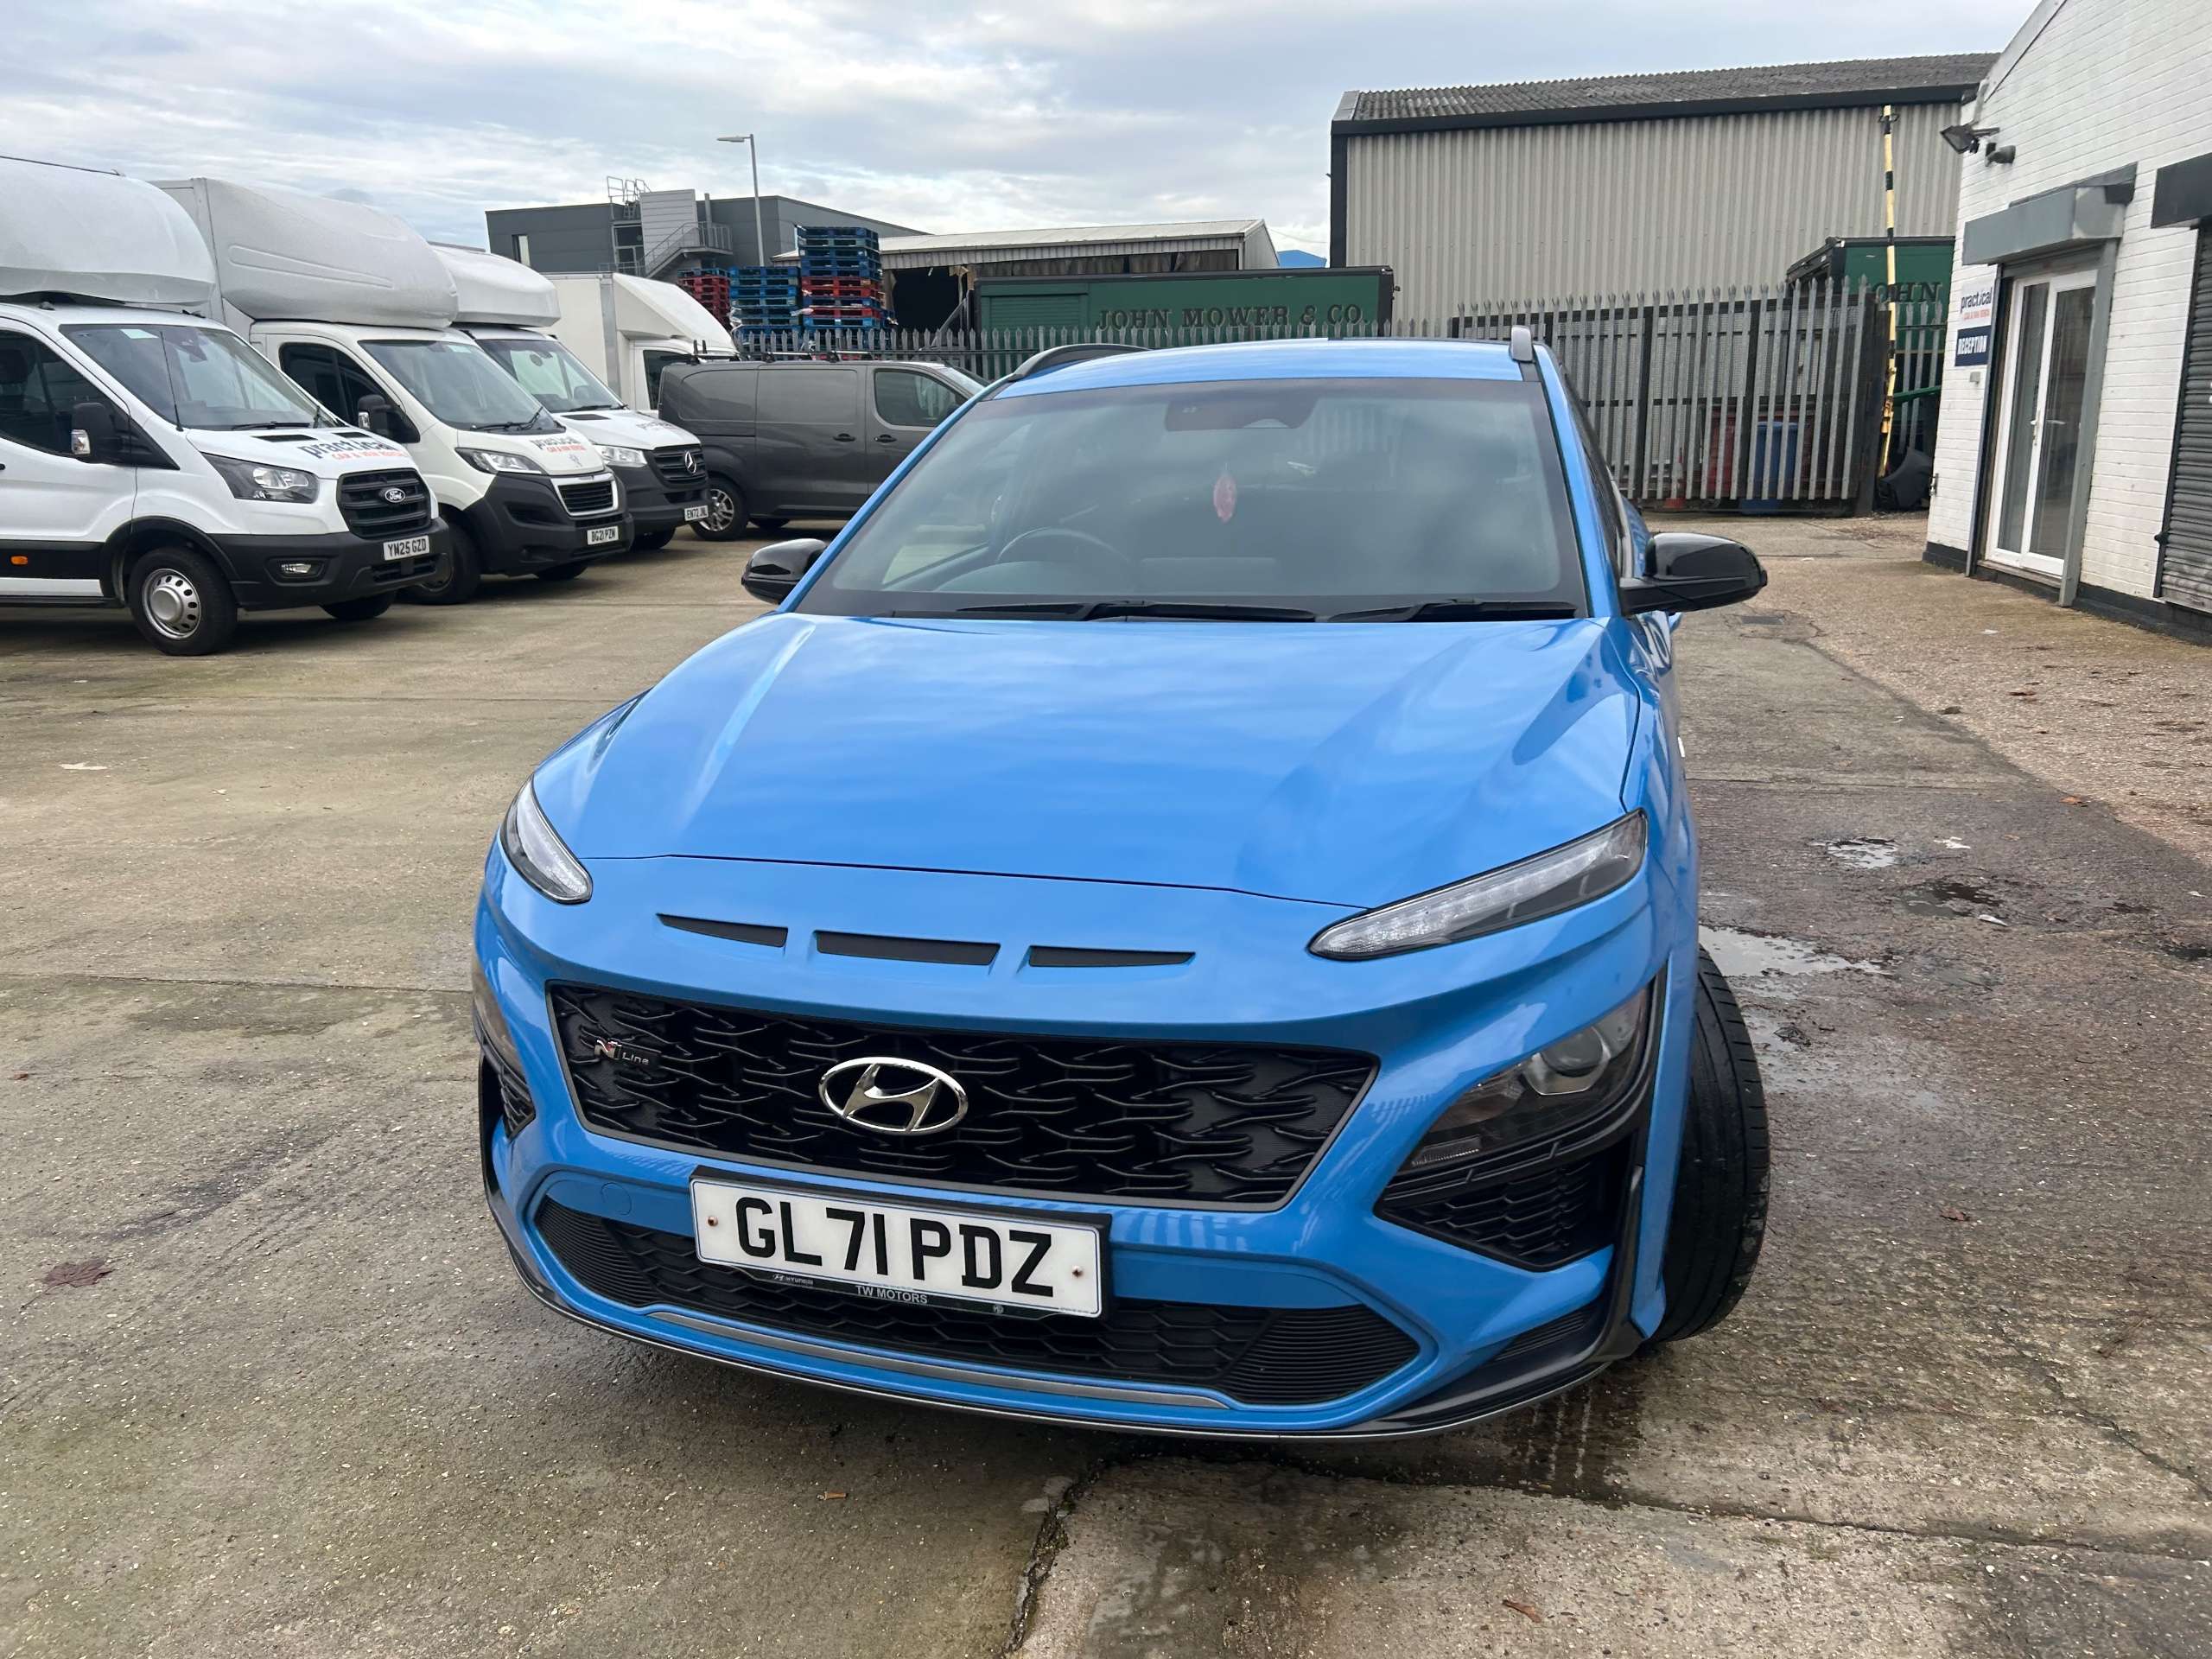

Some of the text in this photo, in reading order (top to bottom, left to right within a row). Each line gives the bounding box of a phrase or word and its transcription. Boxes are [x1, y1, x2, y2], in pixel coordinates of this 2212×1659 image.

[1867, 281, 1942, 304] OHN
[1960, 287, 1993, 314] practical
[1096, 304, 1370, 330] JOHN MOWER & CO.
[1956, 334, 1988, 356] RECEPTION
[297, 440, 400, 459] practical
[622, 1052, 650, 1065] Line
[735, 1196, 1054, 1297] GL71 PDZ
[855, 1285, 874, 1297] TW
[877, 1287, 928, 1304] MOTORS
